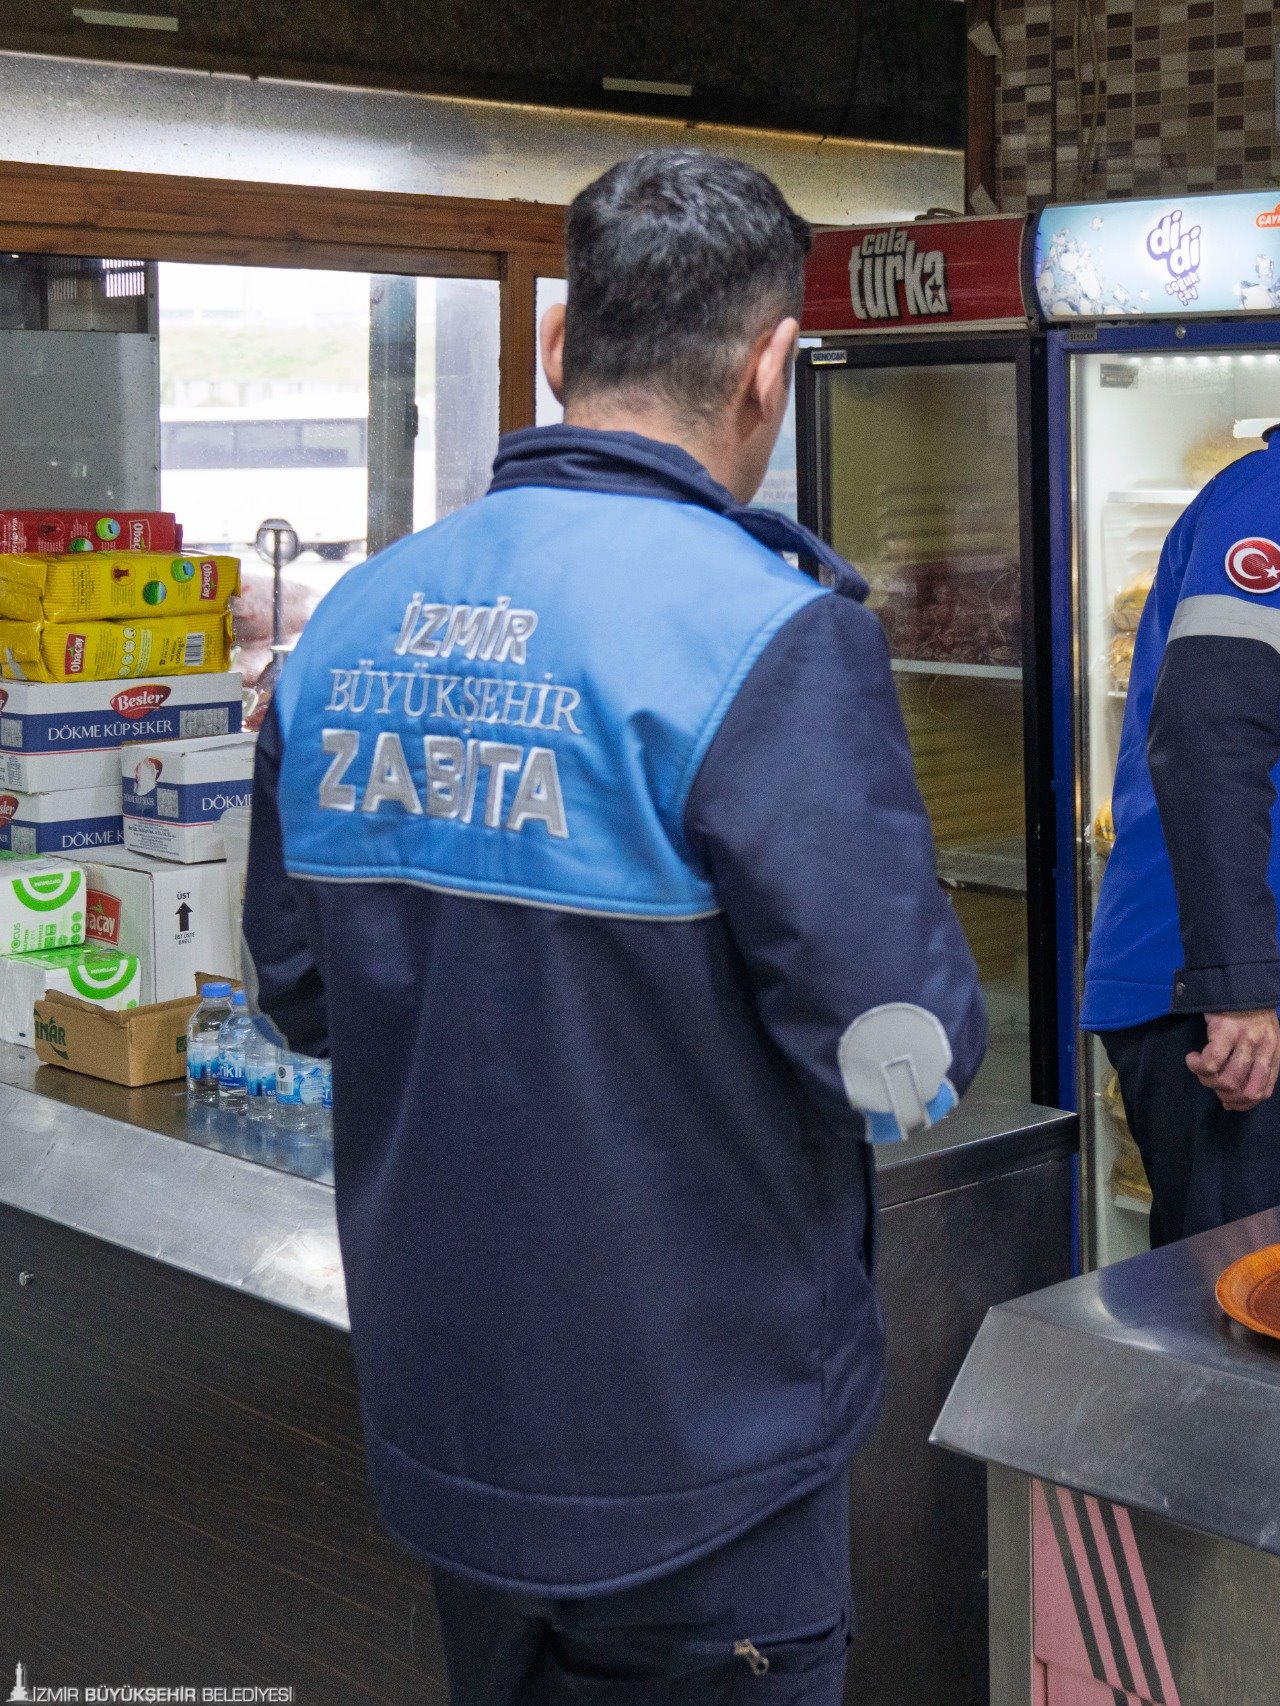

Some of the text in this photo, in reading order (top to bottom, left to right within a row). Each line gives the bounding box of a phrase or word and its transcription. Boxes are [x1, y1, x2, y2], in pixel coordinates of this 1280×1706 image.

[861, 227, 908, 256] cola
[848, 240, 950, 320] turka
[394, 592, 539, 665] İZMİR
[117, 690, 164, 712] Besler
[48, 719, 173, 741] DÖKME KÜP ŞEKER
[318, 728, 570, 840] ZABITA
[62, 832, 115, 848] DÖKME
[176, 891, 191, 900] ÜST
[88, 917, 116, 938] açay
